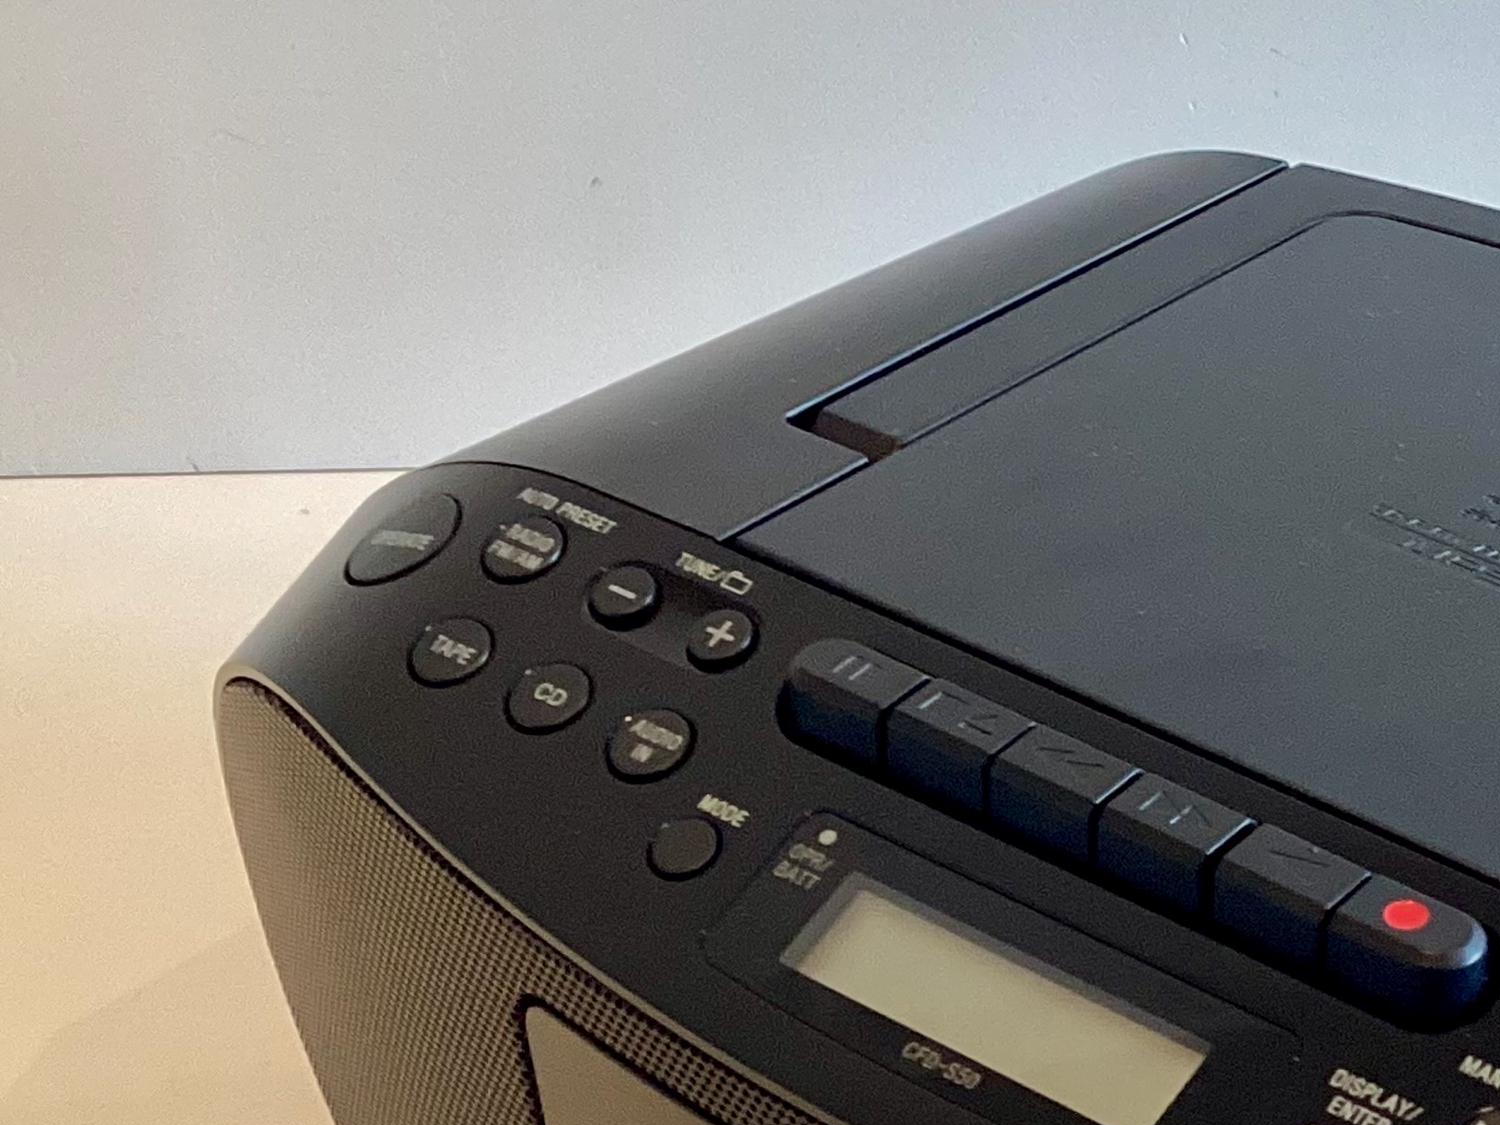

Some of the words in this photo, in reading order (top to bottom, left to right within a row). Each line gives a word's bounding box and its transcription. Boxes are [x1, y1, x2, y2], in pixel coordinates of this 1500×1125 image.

[557, 502, 618, 534] PRESET
[430, 634, 479, 665] TAPE
[534, 683, 568, 706] CD
[697, 794, 750, 828] MODE
